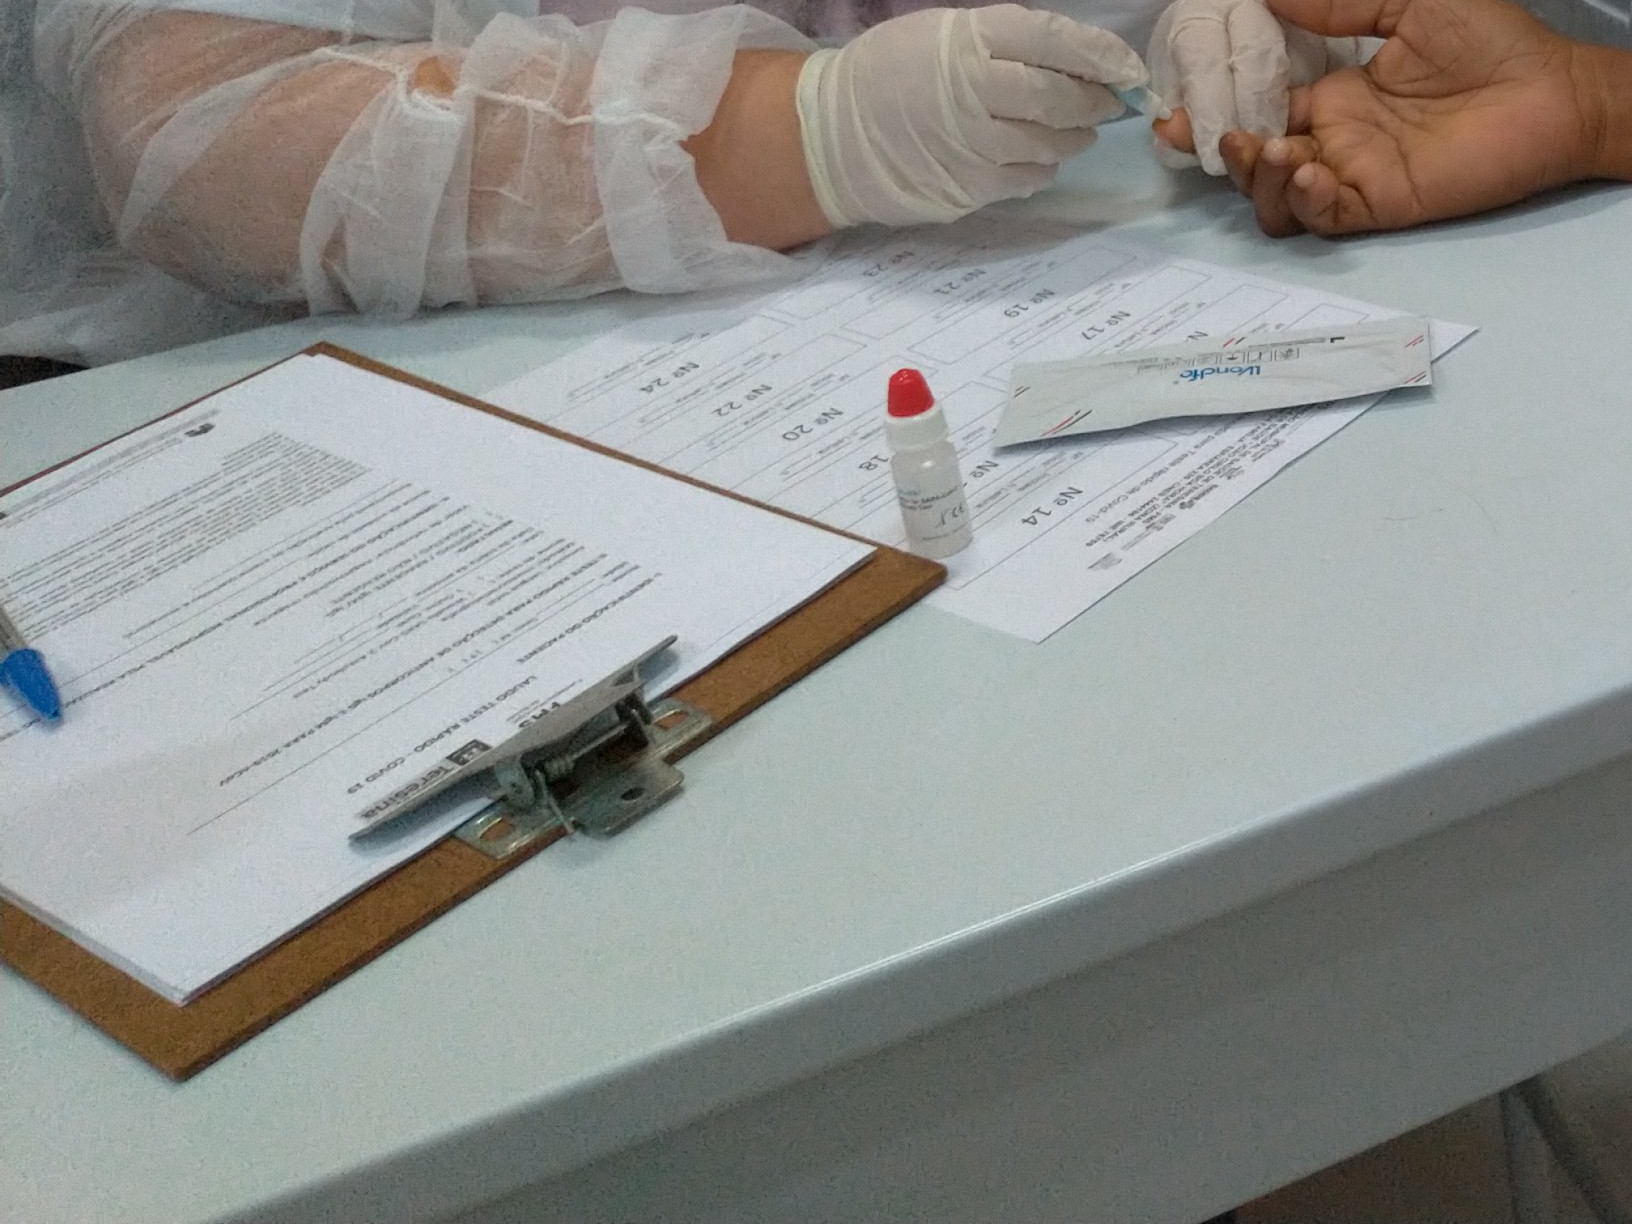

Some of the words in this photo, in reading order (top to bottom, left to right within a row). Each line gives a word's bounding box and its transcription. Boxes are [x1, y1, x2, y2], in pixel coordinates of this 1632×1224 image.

[934, 280, 961, 295] 21
[1003, 302, 1031, 318] 19
[1080, 324, 1105, 341] 17
[1179, 360, 1261, 382] Wondfo
[639, 378, 670, 394] 24
[711, 401, 743, 417] 22
[782, 424, 814, 441] 20
[858, 454, 889, 471] 18
[1021, 506, 1052, 526] 14
[496, 675, 537, 701] LAUDO
[460, 702, 496, 723] TESTE
[413, 723, 461, 753] RÁPIDO
[365, 757, 405, 783] COVID
[347, 783, 364, 794] 19
[361, 766, 453, 819] Teresina
